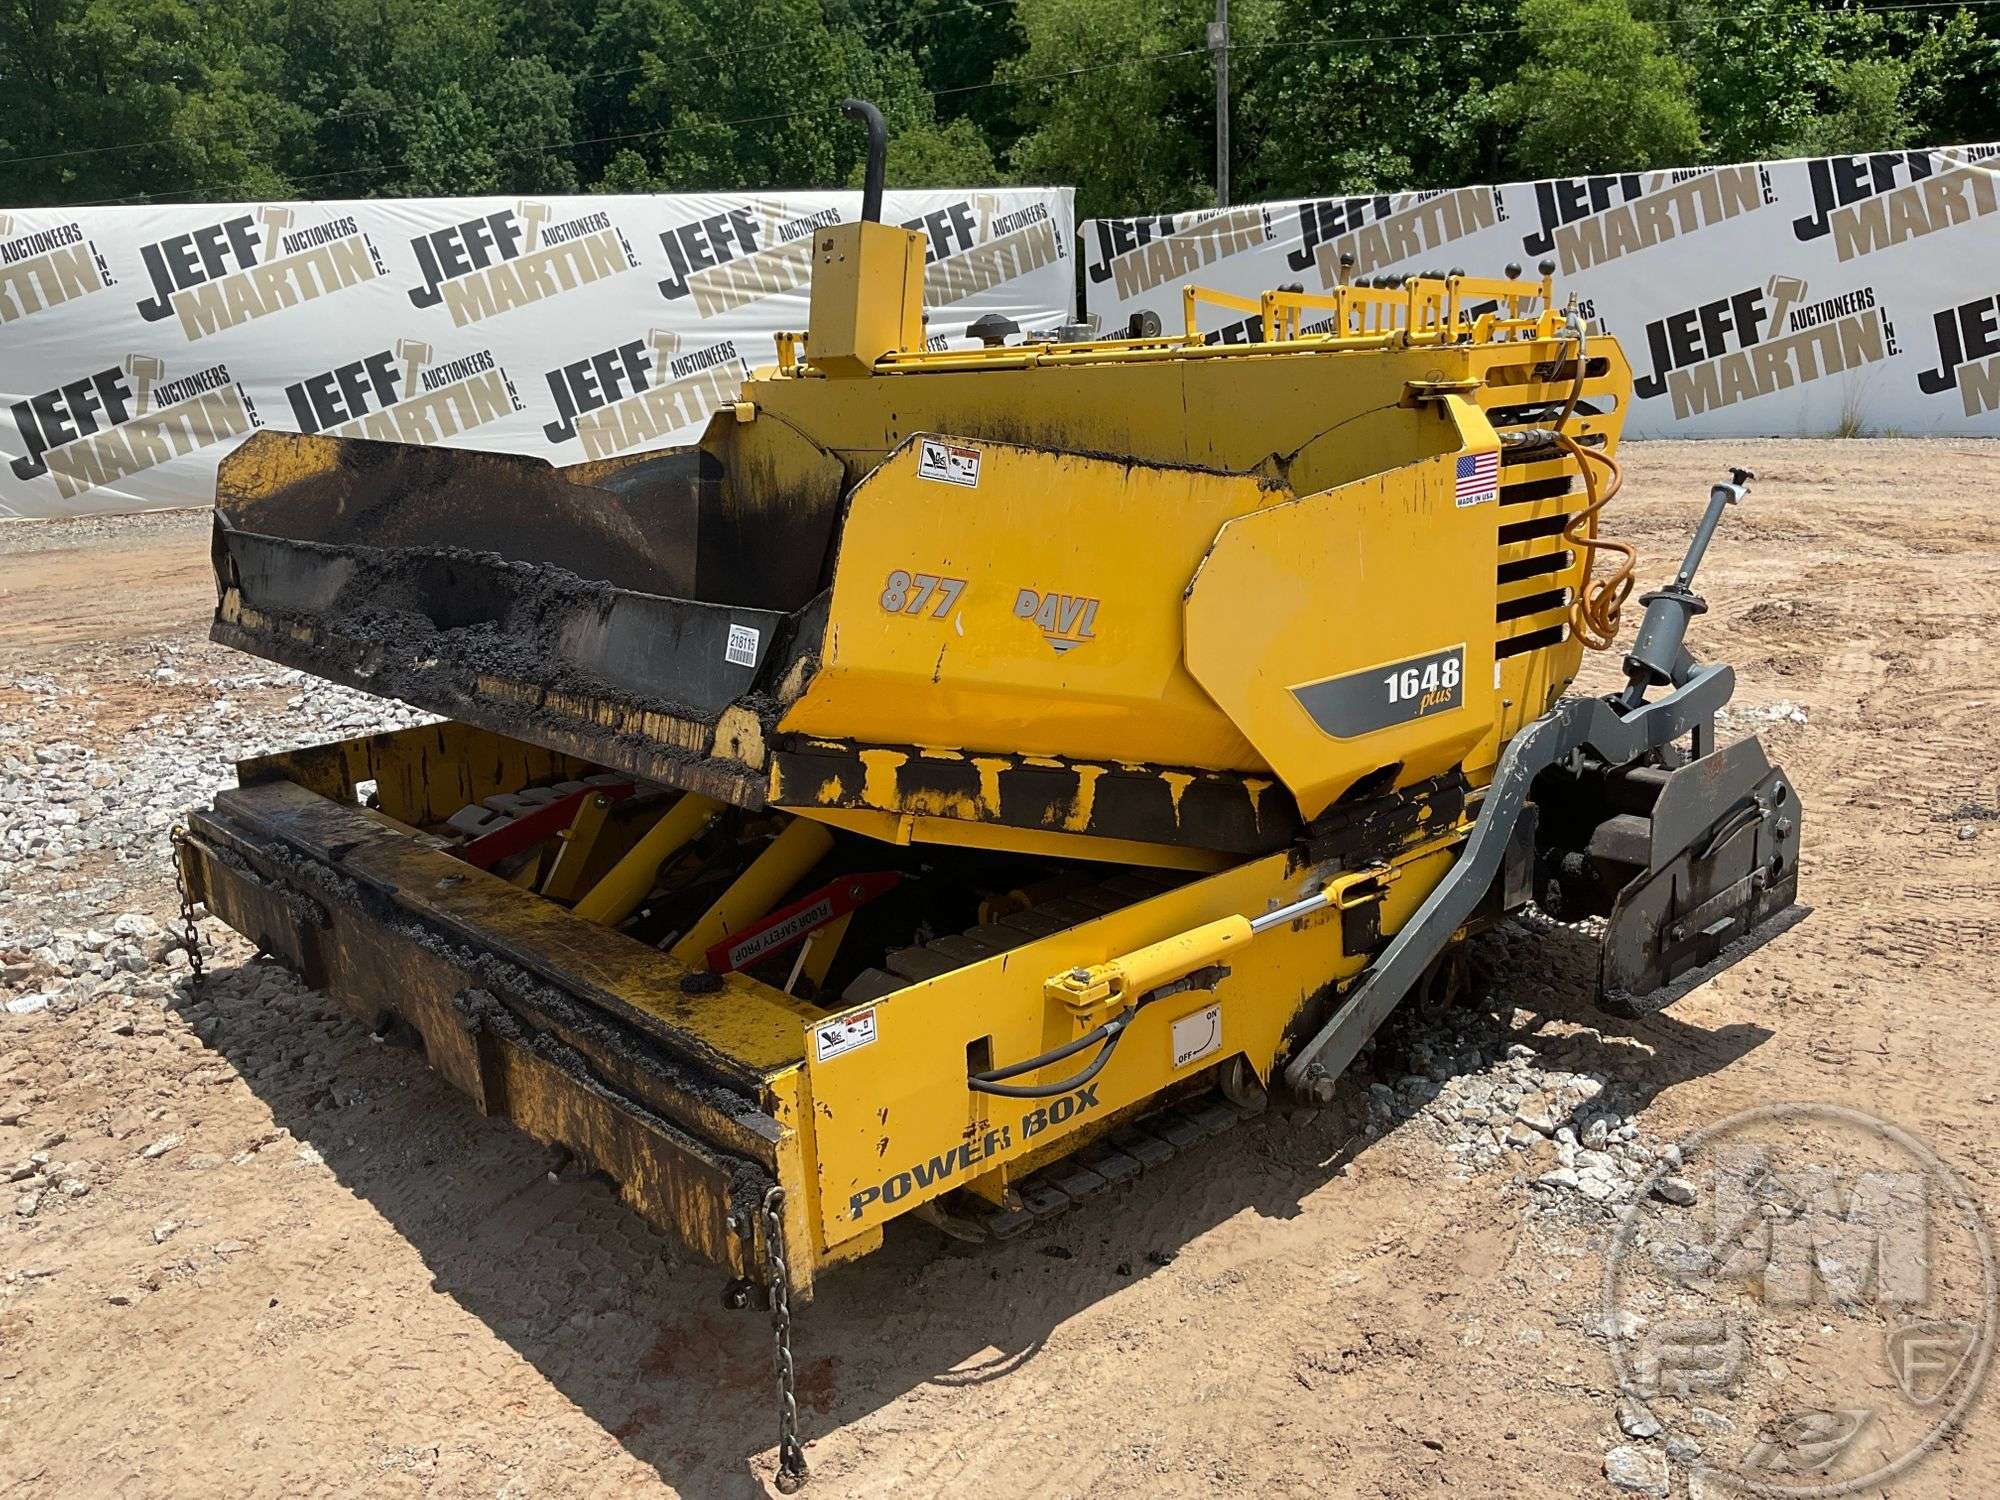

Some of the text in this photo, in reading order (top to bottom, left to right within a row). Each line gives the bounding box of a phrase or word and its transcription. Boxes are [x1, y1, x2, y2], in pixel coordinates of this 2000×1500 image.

[541, 211, 611, 249] AUCTIONEERS
[778, 207, 841, 242] AUCTIONEERS
[992, 202, 1048, 238] AUCTIONEERS
[1554, 166, 1760, 276] MARTIN
[1830, 157, 2000, 263] MART
[1, 223, 83, 264] AUCTIONEERS
[283, 216, 358, 255] AUCTIONEERS
[363, 233, 390, 276] INC.
[408, 209, 522, 309] JEFF
[616, 227, 641, 268] INC.
[658, 205, 761, 300] JEFF
[1052, 217, 1068, 259] INC.
[1111, 207, 1265, 301] MARTIN
[1314, 186, 1496, 290] MARTIN
[89, 240, 118, 287] INC.
[136, 215, 261, 322] JEFF
[172, 233, 377, 342] MARTIN
[440, 228, 628, 328] MARTIN
[1789, 286, 1875, 332] AUCTIONEERS
[1880, 306, 1903, 356] INC.
[670, 340, 737, 379] AUCTIONEERS
[1633, 287, 1768, 399] JEFF
[1666, 310, 1885, 421] MARTIN
[154, 364, 231, 408] AUCTIONEERS
[421, 350, 495, 391] AUCTIONEERS
[500, 367, 526, 411] INC.
[543, 339, 653, 444] JEFF
[9, 366, 133, 481] JEFF
[236, 382, 265, 427] INC.
[320, 370, 513, 445] ARTIN
[575, 360, 741, 462] MARTIN
[45, 384, 250, 500] MARTIN
[1458, 496, 1473, 505] MADE
[1482, 492, 1493, 500] USA
[879, 569, 968, 619] 877
[1384, 658, 1460, 704] 1648
[1420, 686, 1452, 715] plus
[735, 903, 829, 962] FLOOR SAFETY PROP
[1206, 1008, 1217, 1020] ON
[1178, 1050, 1192, 1063] OFF
[849, 1082, 1100, 1221] POWER BOX
